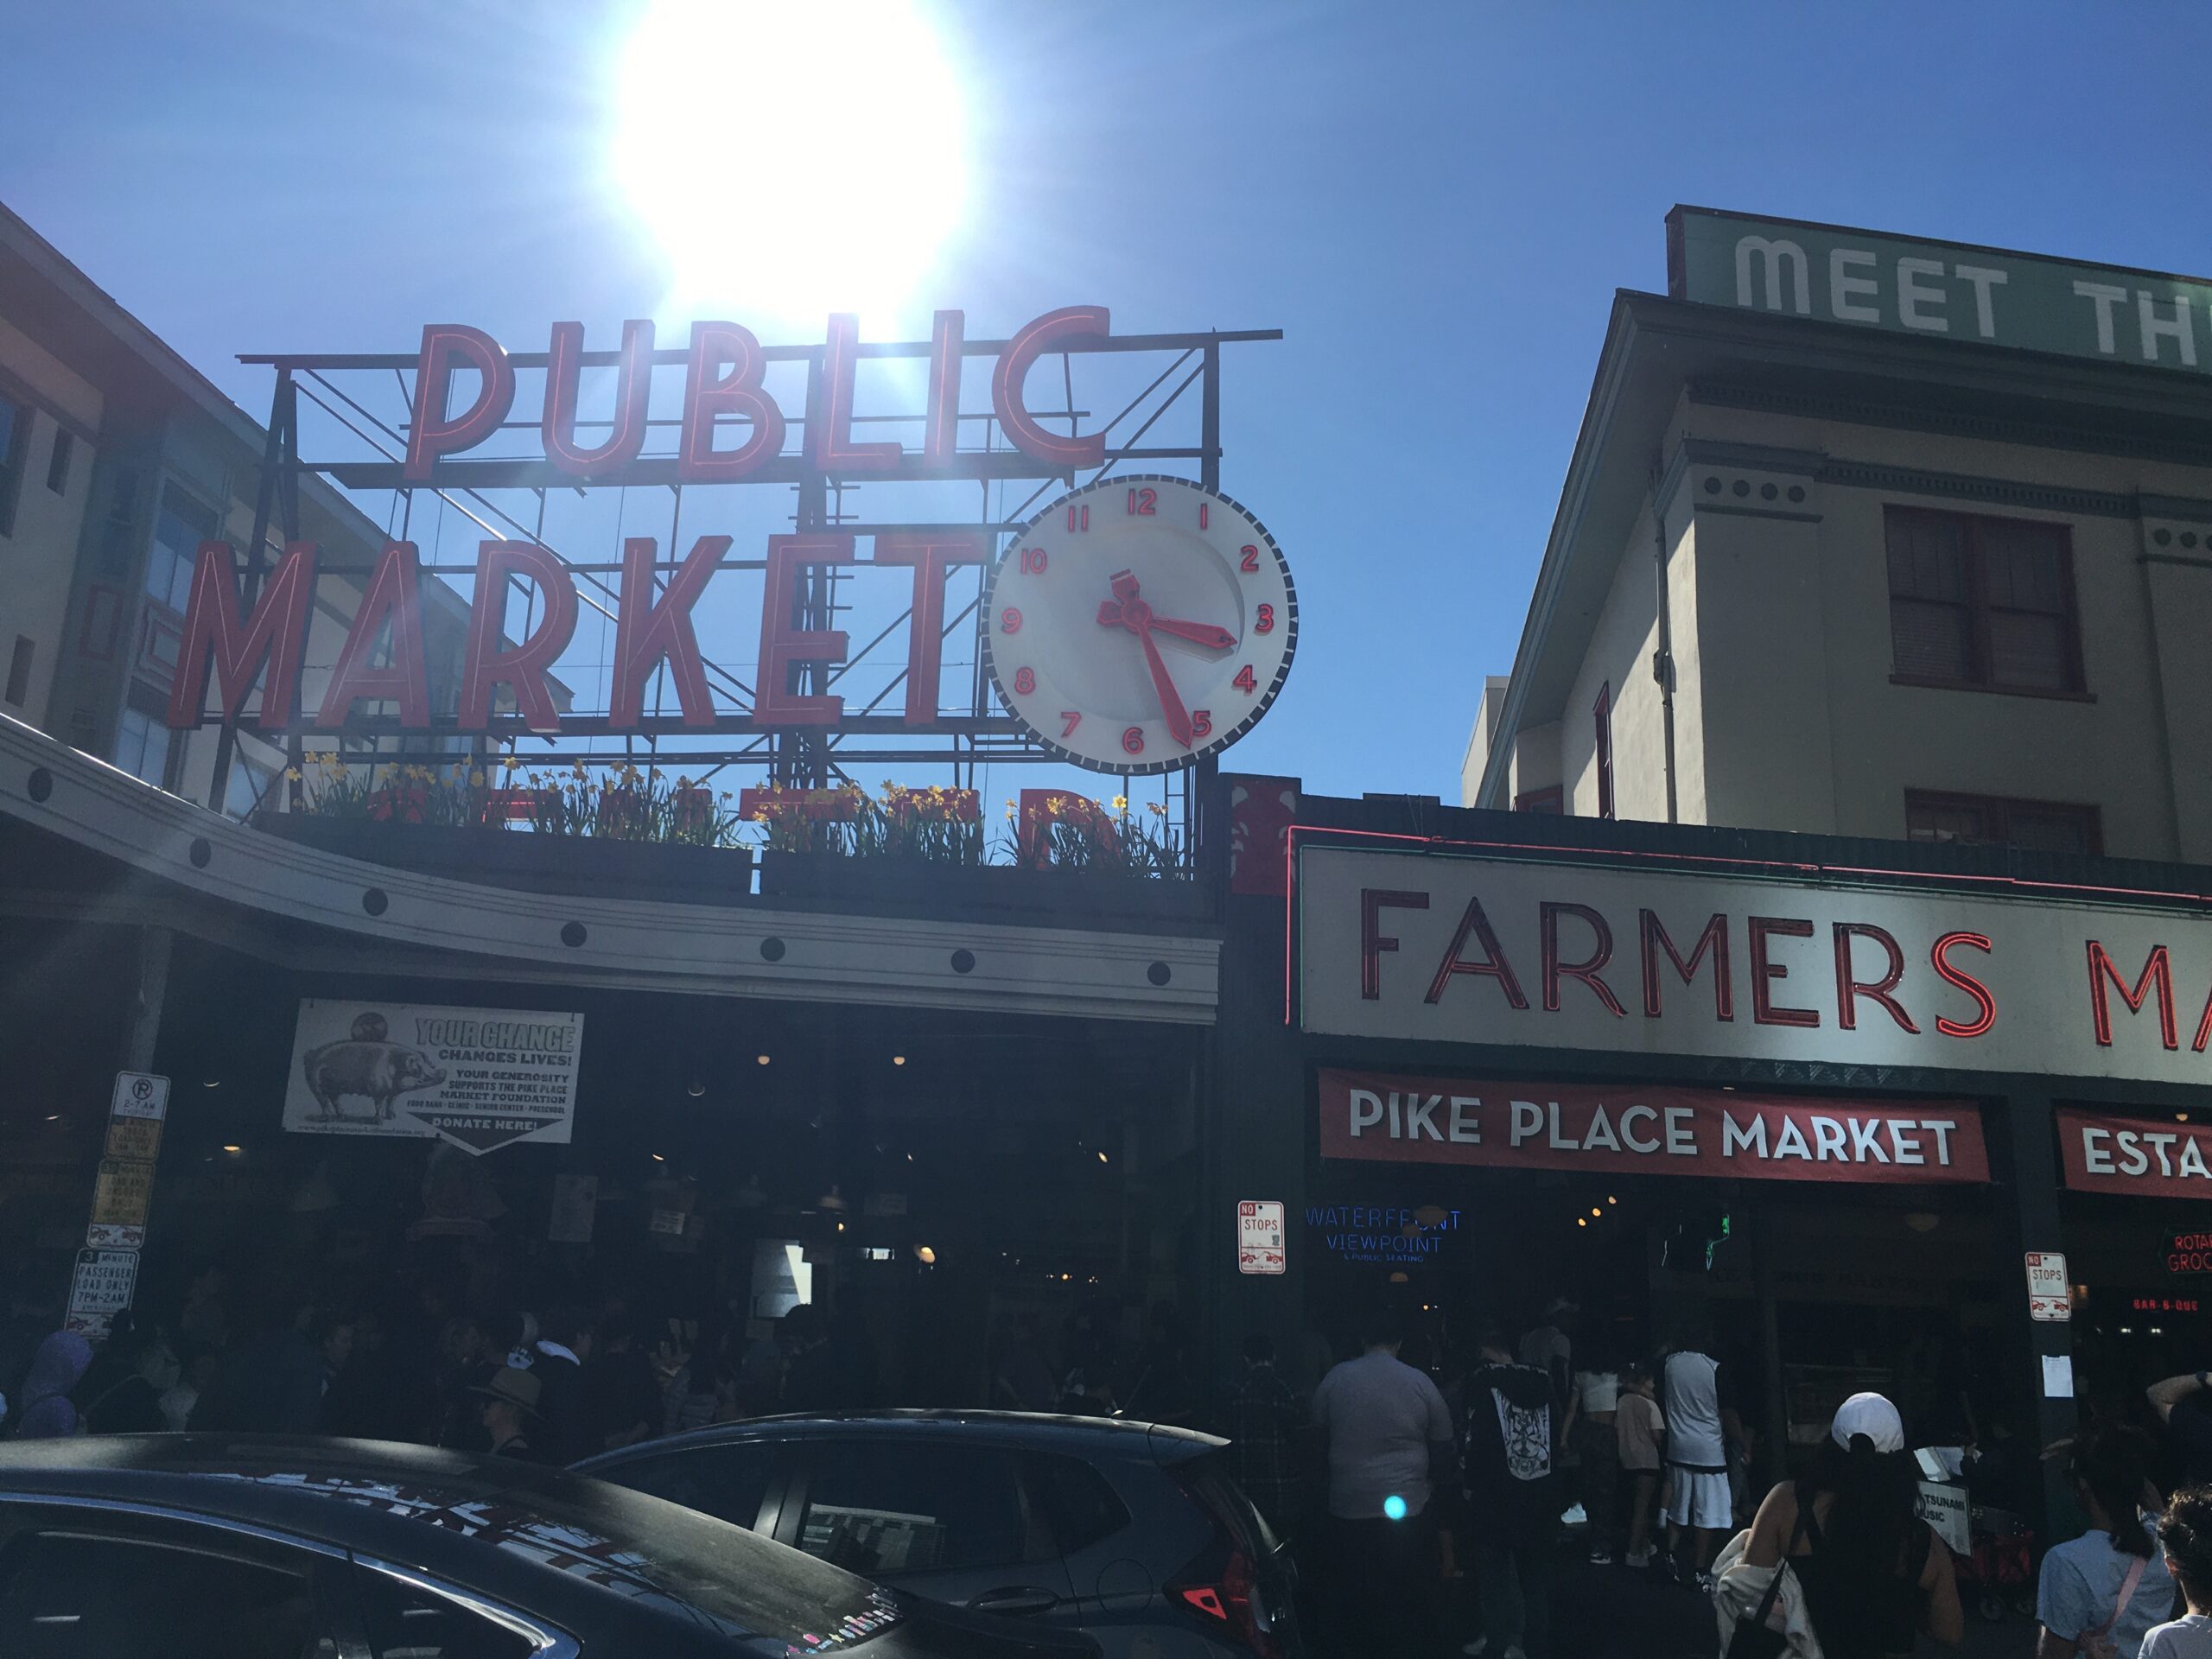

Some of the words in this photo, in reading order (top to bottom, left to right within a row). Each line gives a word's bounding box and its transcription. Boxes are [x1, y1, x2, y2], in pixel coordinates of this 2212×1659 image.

[1734, 235, 2008, 338] MEET
[2073, 282, 2212, 368] TH
[404, 305, 1110, 480] PUBLIC
[1127, 488, 1156, 516] 12
[1067, 505, 1089, 532] 11
[1199, 504, 1208, 530] 1
[1020, 548, 1047, 575] 10
[1239, 545, 1260, 573] 2
[1001, 607, 1022, 634] 9
[1255, 603, 1274, 633] 3
[168, 533, 992, 733] MARKET
[1014, 667, 1036, 694] 8
[1233, 664, 1258, 693] 4
[1061, 711, 1082, 738] 7
[1193, 710, 1211, 737] 5
[1123, 728, 1144, 754] 6
[1361, 888, 1996, 1038] FARMERS
[2085, 939, 2212, 1052] M
[416, 1018, 480, 1048] YOUR
[480, 1021, 575, 1052] CHANGE
[439, 1049, 517, 1064] CHANGES
[520, 1053, 572, 1066] LIVES!
[448, 1080, 496, 1091] SUPPORTS
[499, 1082, 516, 1092] THE
[518, 1084, 537, 1093] PIKE
[540, 1084, 568, 1095] PLACE
[456, 1069, 489, 1079] YOUR
[492, 1071, 569, 1083] GENEROSITY
[440, 1090, 489, 1101] MARKET
[492, 1092, 567, 1103] FOUNDATION
[432, 1116, 491, 1129] DONATE
[495, 1119, 537, 1131] HERE!
[1350, 1089, 1481, 1144] PIKE
[1510, 1100, 1698, 1155] PLACE
[1722, 1109, 1955, 1166] MARKET
[2082, 1127, 2212, 1179] ESTA
[1241, 1205, 1254, 1215] NO
[1244, 1218, 1278, 1231] STOPS
[1326, 1233, 1445, 1254] VIEWPOINT
[85, 1251, 93, 1262] 3
[102, 1254, 134, 1263] MINUTE
[1351, 1253, 1382, 1262] PUBLIC
[1385, 1254, 1425, 1263] SEATING
[2027, 1255, 2039, 1265] NO
[77, 1279, 101, 1290] LOAD
[106, 1280, 130, 1291] ONLY
[79, 1266, 132, 1279] PASSENGER
[2032, 1268, 2062, 1281] STOPS
[78, 1291, 126, 1303] 7PM-2AM
[1922, 1509, 1945, 1522] USIC
[1923, 1494, 1965, 1511] TSUNAMI
